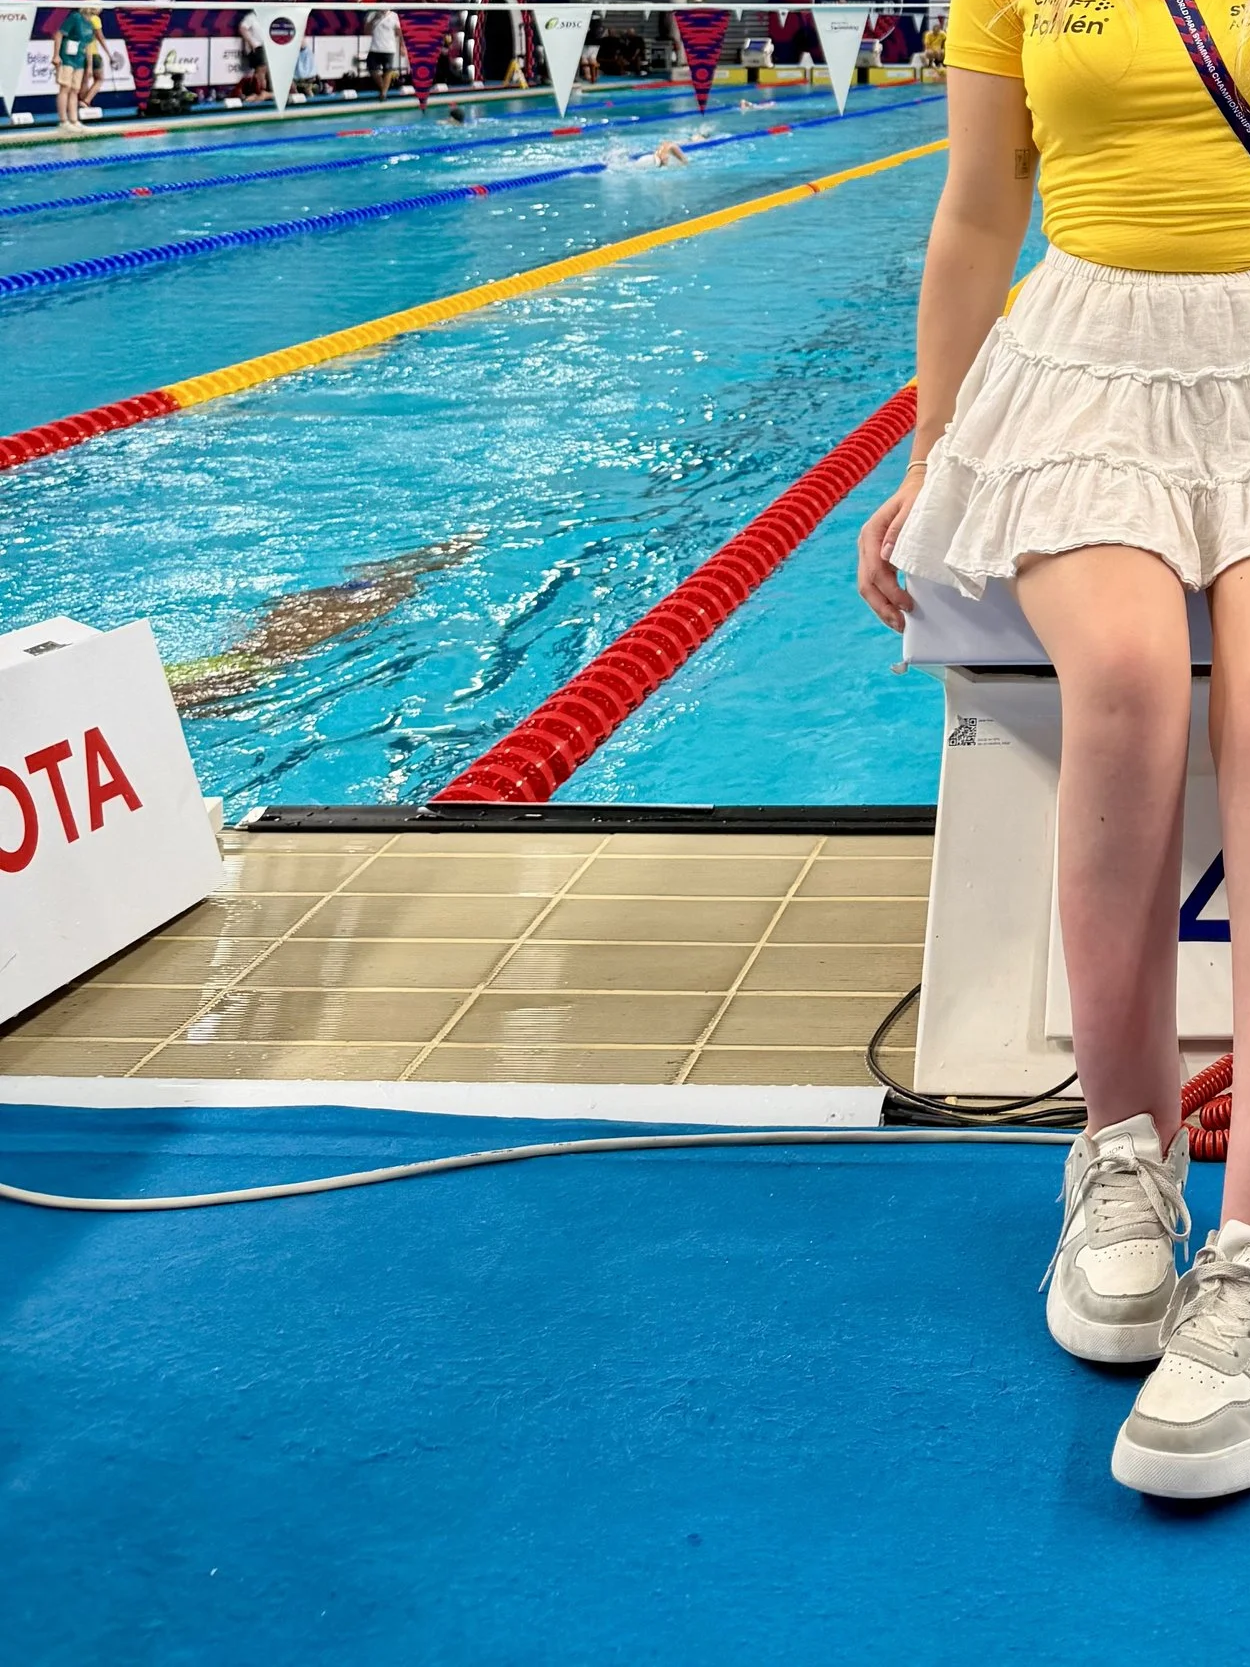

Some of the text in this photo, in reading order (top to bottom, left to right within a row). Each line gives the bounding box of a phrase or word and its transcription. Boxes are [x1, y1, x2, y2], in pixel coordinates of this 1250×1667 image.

[0, 13, 27, 21] YOTA
[560, 21, 583, 29] SDSC
[1184, 15, 1197, 34] PARA
[1192, 33, 1216, 73] SWIMMING
